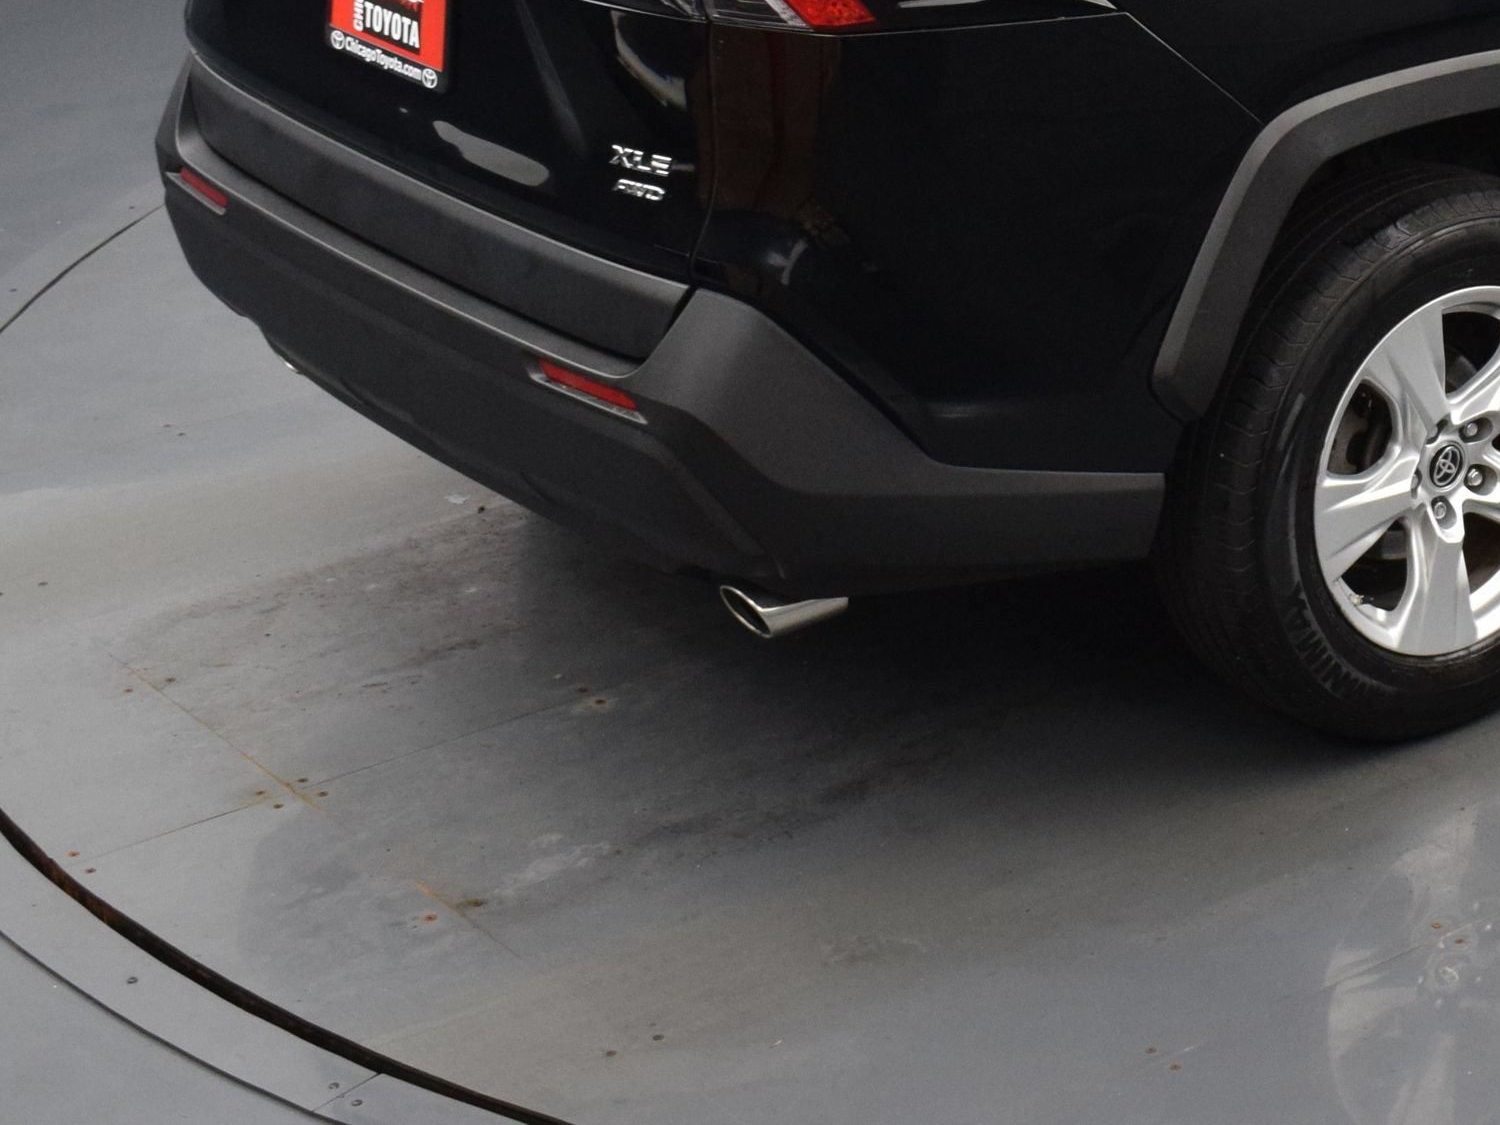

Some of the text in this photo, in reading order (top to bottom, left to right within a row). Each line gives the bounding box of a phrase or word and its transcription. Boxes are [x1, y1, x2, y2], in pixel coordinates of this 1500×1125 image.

[364, 1, 420, 48] TOYOTA
[345, 36, 422, 81] ChicagoToyota.com
[609, 144, 672, 177] XLE
